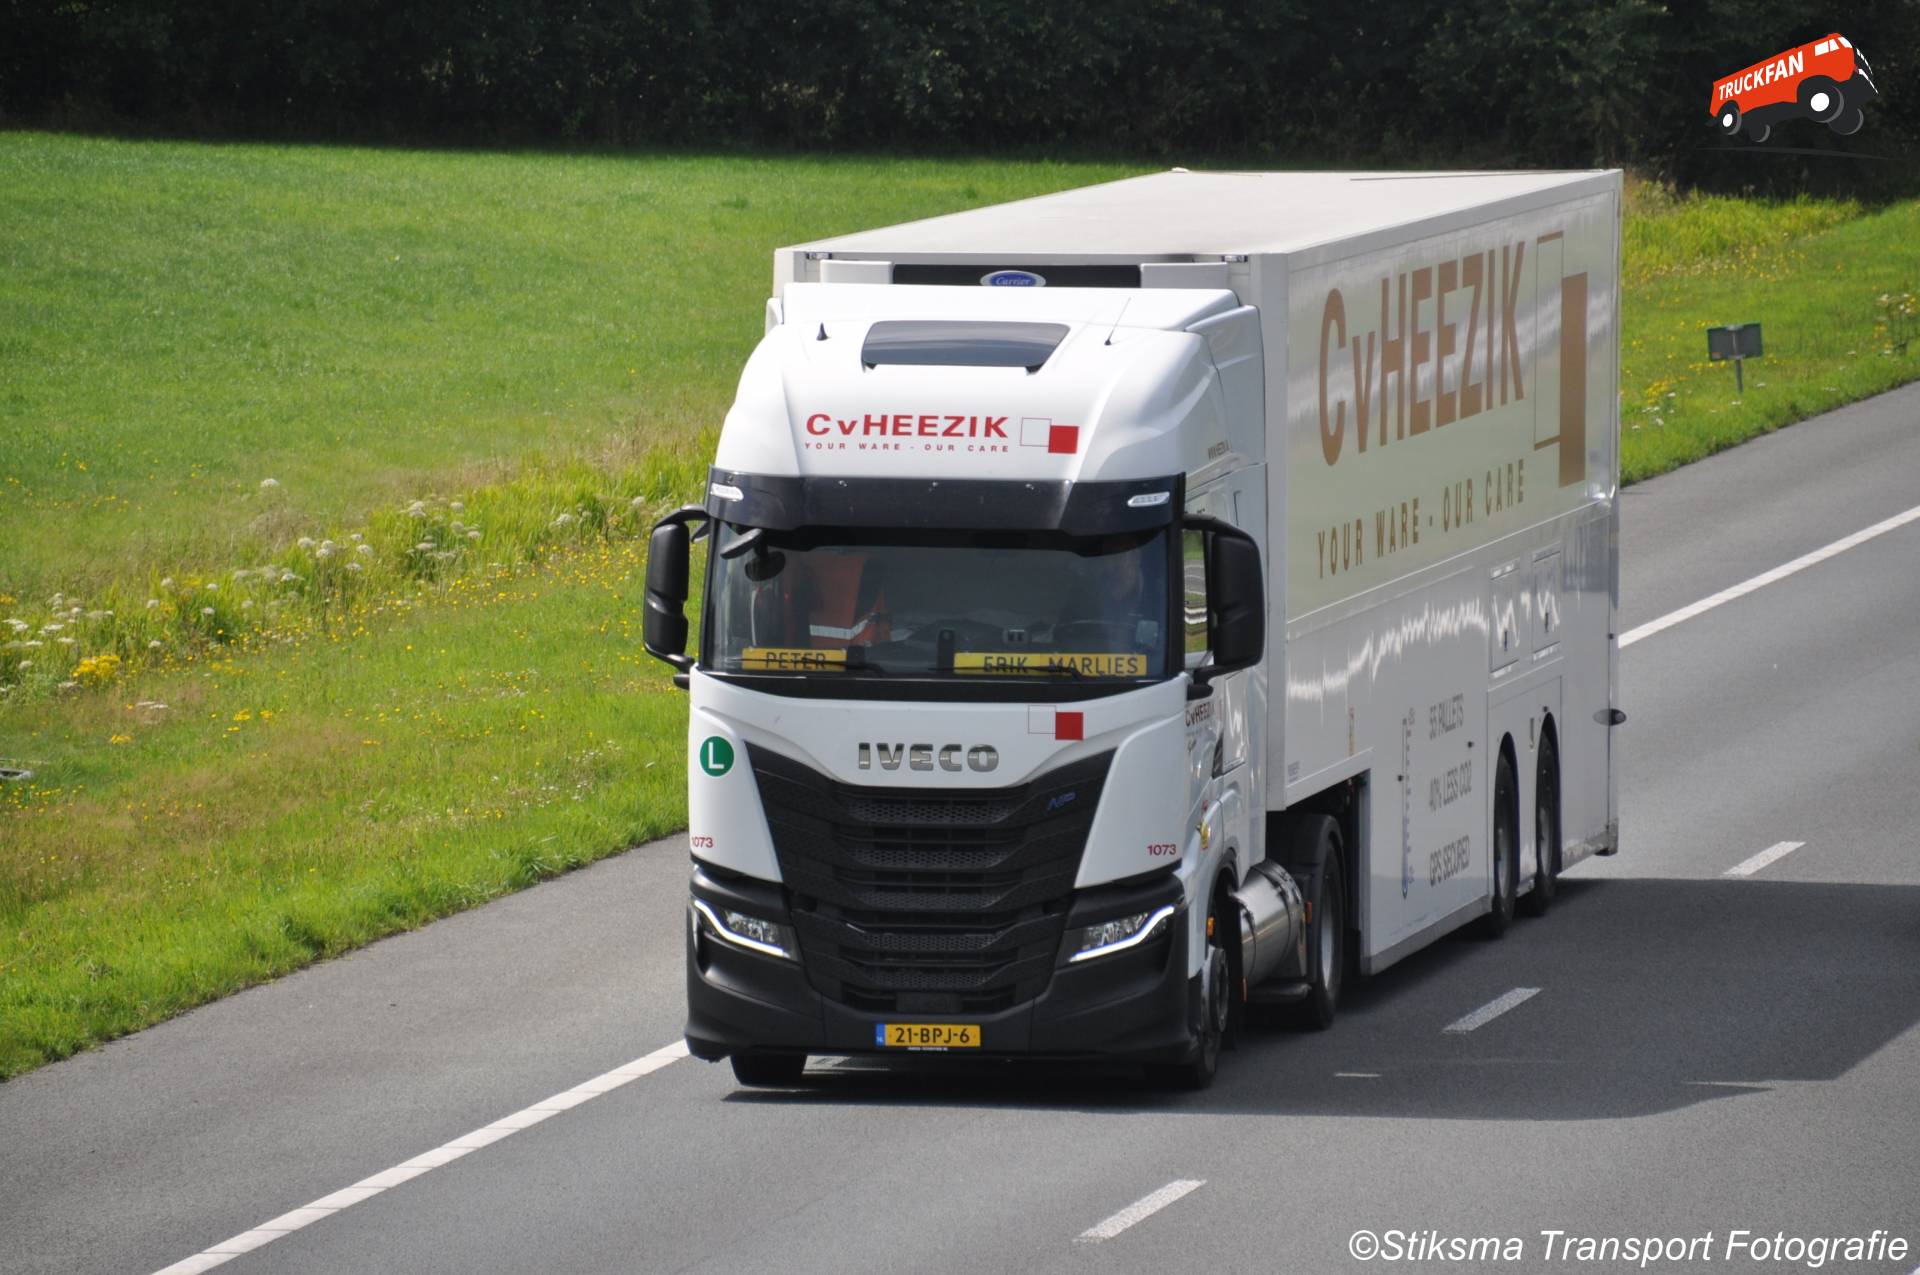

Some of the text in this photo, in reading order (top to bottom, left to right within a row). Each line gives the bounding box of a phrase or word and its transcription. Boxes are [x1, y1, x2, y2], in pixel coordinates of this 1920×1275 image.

[995, 275, 1032, 287] Carrier
[1319, 240, 1525, 466] CvHEEZIK
[806, 413, 1009, 438] CvHEEZIK
[804, 442, 846, 450] YOUR
[858, 443, 901, 451] WARE
[967, 444, 1009, 452] CARE
[1318, 517, 1363, 579] YOUR
[1376, 497, 1419, 558] WARE
[1443, 478, 1473, 532] OUR
[1485, 458, 1524, 516] CARE
[765, 651, 826, 669] PETER
[983, 656, 1139, 674] ERIK MARLIES
[708, 742, 725, 769] L
[858, 742, 1000, 773] IVECO
[1147, 843, 1177, 856] 1073
[895, 1027, 970, 1044] 21-BPJ-6
